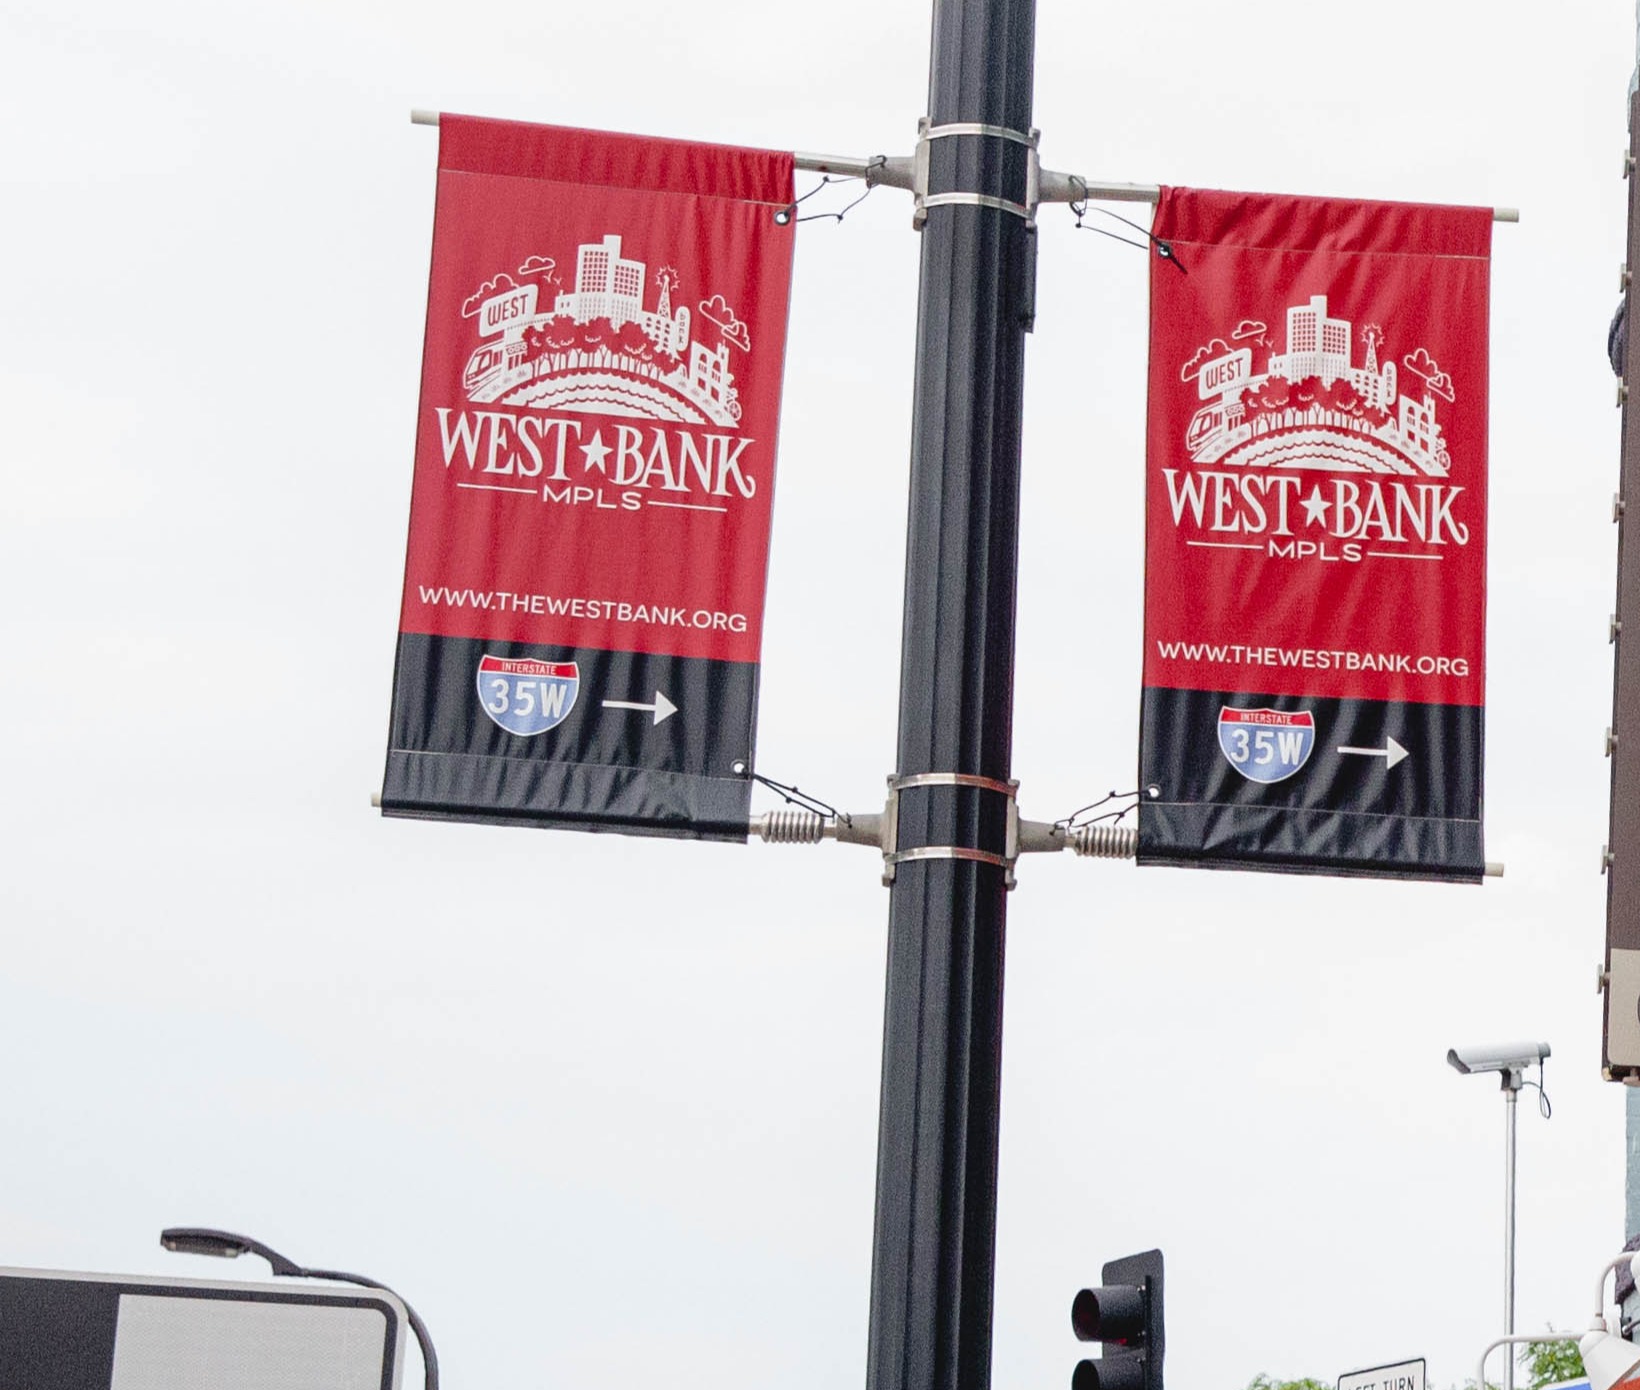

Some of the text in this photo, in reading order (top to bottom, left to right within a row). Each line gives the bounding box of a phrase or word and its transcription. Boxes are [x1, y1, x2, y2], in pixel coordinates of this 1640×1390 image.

[487, 293, 529, 326] WEST
[1206, 357, 1244, 390] WEST
[435, 407, 756, 499] WEST BANK
[542, 484, 642, 511] MPLS
[1162, 468, 1469, 546] WEST BANK
[1268, 539, 1362, 562] MPLS
[418, 585, 748, 633] WWW.THEWESTBANK.ORG
[501, 661, 557, 675] INTERSTATE
[1157, 640, 1469, 677] WWW.THEWESTBANK.ORG
[488, 678, 567, 719] 35W
[1240, 712, 1293, 725] INTERSTATE
[1230, 728, 1304, 766] 35W
